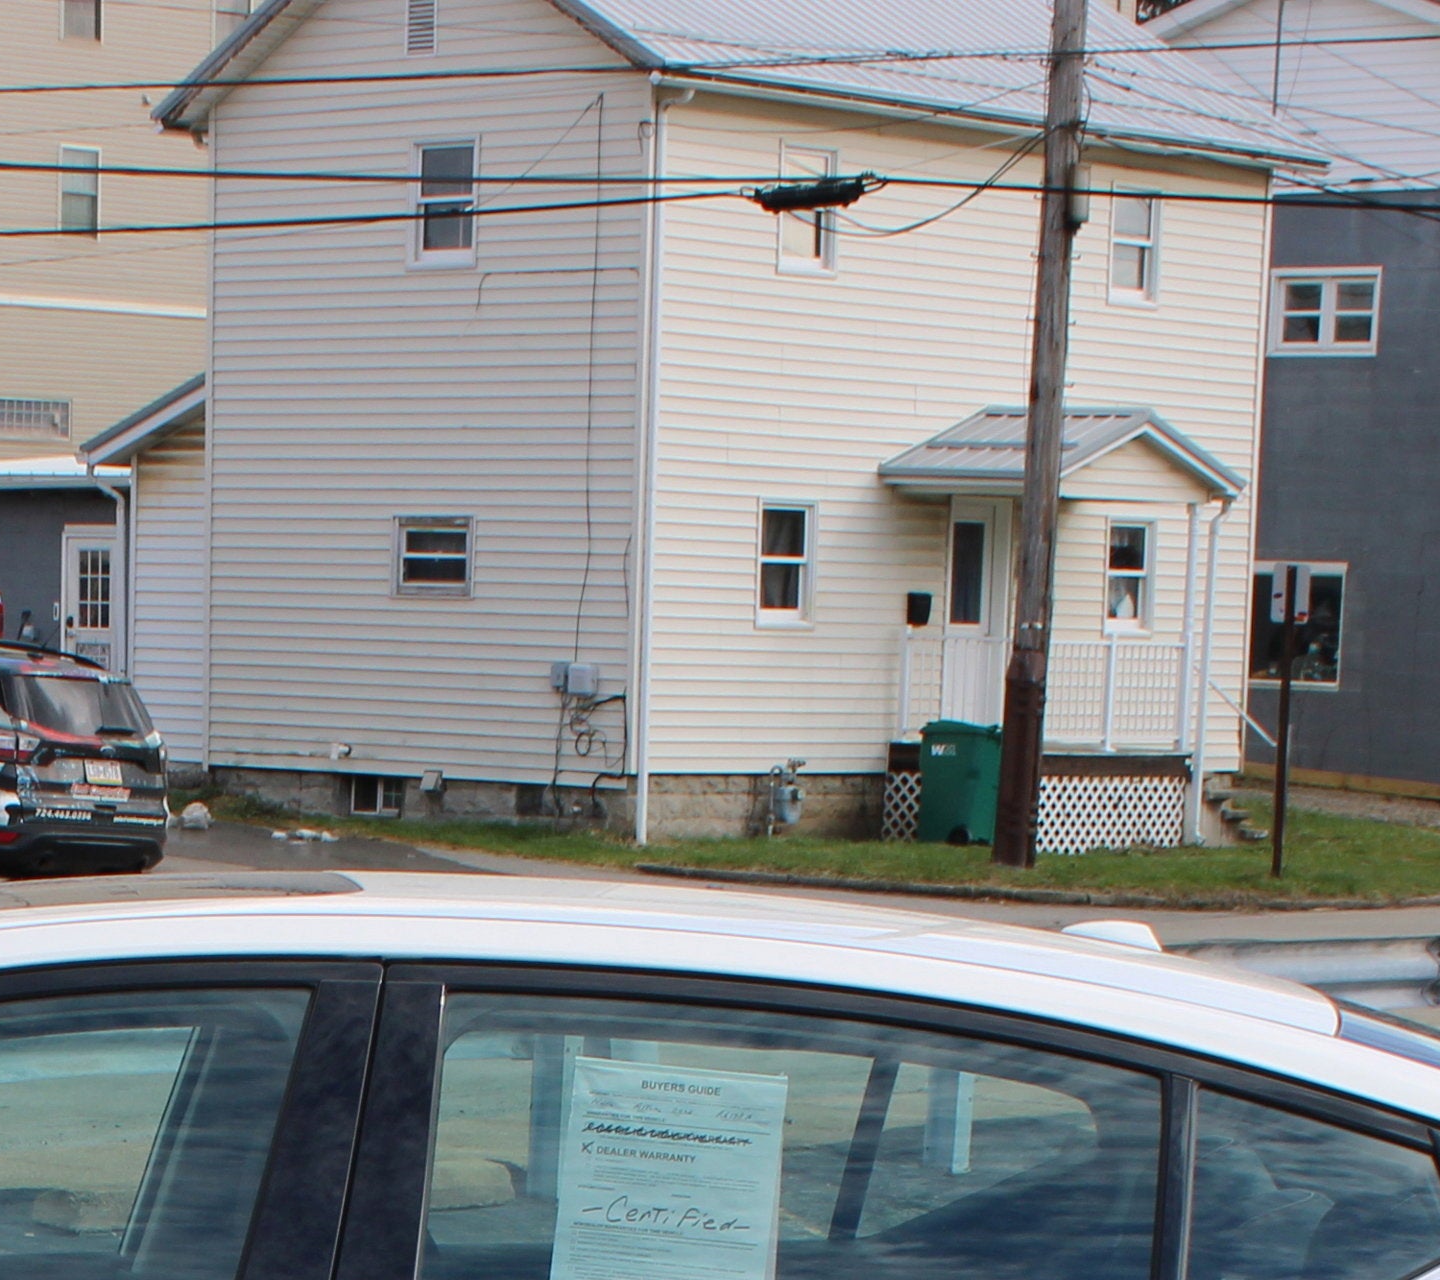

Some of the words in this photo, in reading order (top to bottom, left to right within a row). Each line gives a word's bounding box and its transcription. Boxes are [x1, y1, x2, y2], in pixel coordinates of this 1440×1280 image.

[641, 1079, 685, 1092] BUYERS
[687, 1084, 722, 1097] GUIDE
[596, 1146, 637, 1159] DEALER
[639, 1150, 697, 1163] WARRANTY
